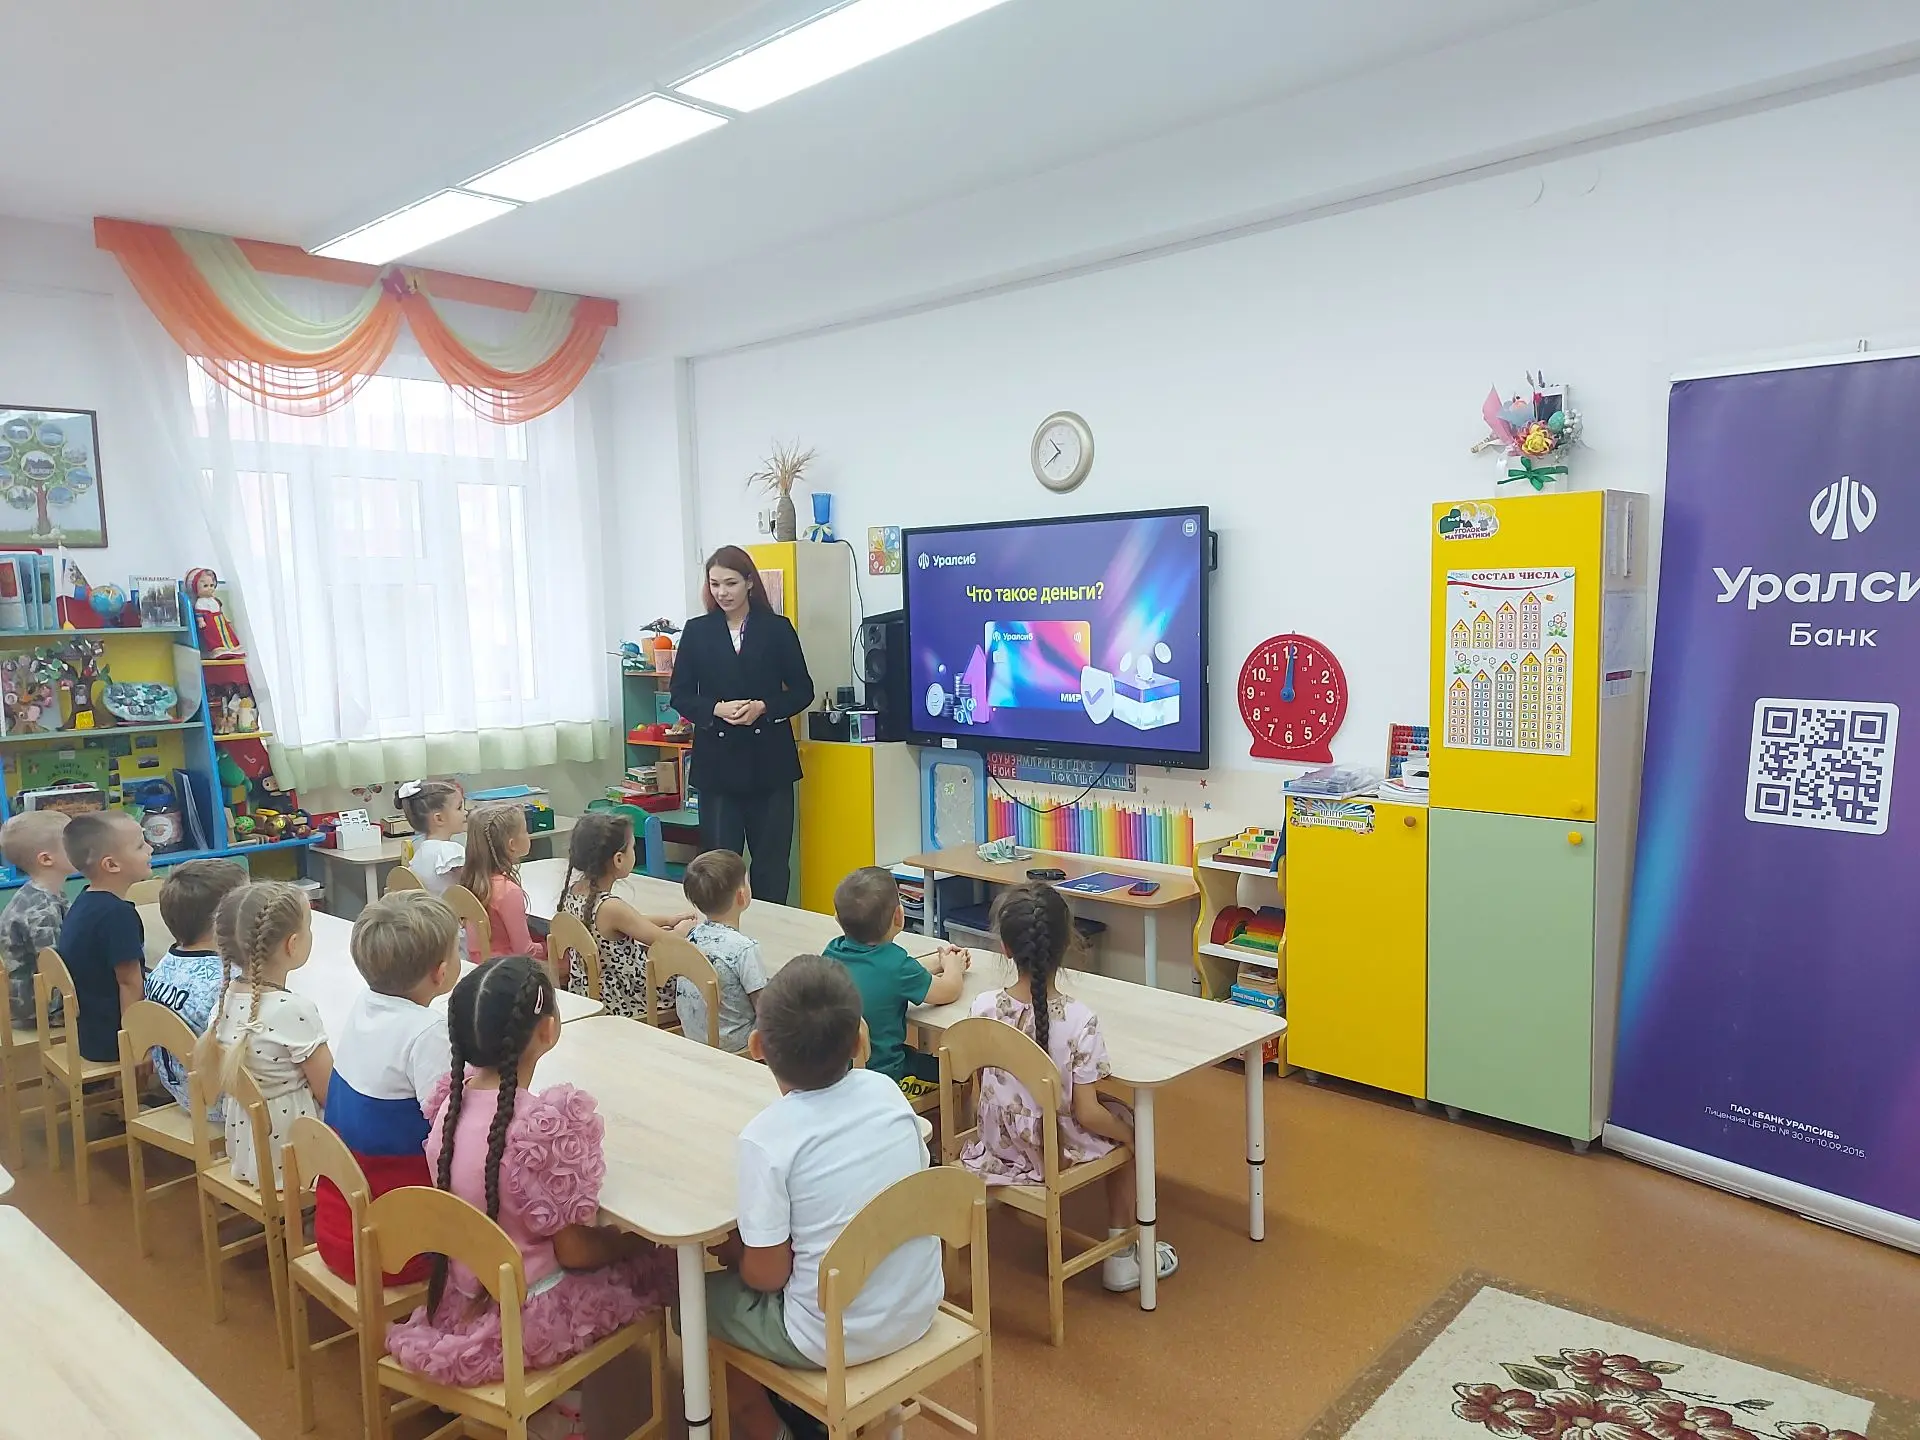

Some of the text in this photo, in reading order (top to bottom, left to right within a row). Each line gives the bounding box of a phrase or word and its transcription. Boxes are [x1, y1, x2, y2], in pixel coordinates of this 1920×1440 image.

[932, 553, 976, 568] Уралсиб
[1471, 571, 1515, 580] СОСТАВ
[1519, 571, 1560, 580] ЧИСЛА
[966, 581, 1104, 604] Что такое деньги?
[1790, 622, 1878, 647] Банк
[1264, 652, 1277, 665] 11
[1306, 653, 1312, 666] 1
[1252, 668, 1266, 681] 10
[1321, 670, 1330, 684] 2
[1060, 693, 1082, 702] МИР
[1246, 686, 1254, 700] 9
[1326, 690, 1334, 704] 3
[1252, 708, 1260, 721] 8
[1318, 712, 1327, 726] 4
[1268, 724, 1275, 736] 7
[1284, 730, 1292, 744] 6
[1304, 726, 1312, 740] 5
[1704, 1106, 1746, 1124] Лицензия
[1748, 1118, 1761, 1128] ЦБ
[1762, 1122, 1776, 1132] РФ
[1778, 1127, 1790, 1136] №
[1791, 1131, 1804, 1140] 30
[1730, 1104, 1840, 1140] ПАО «БАНК УРАЛСИБ»
